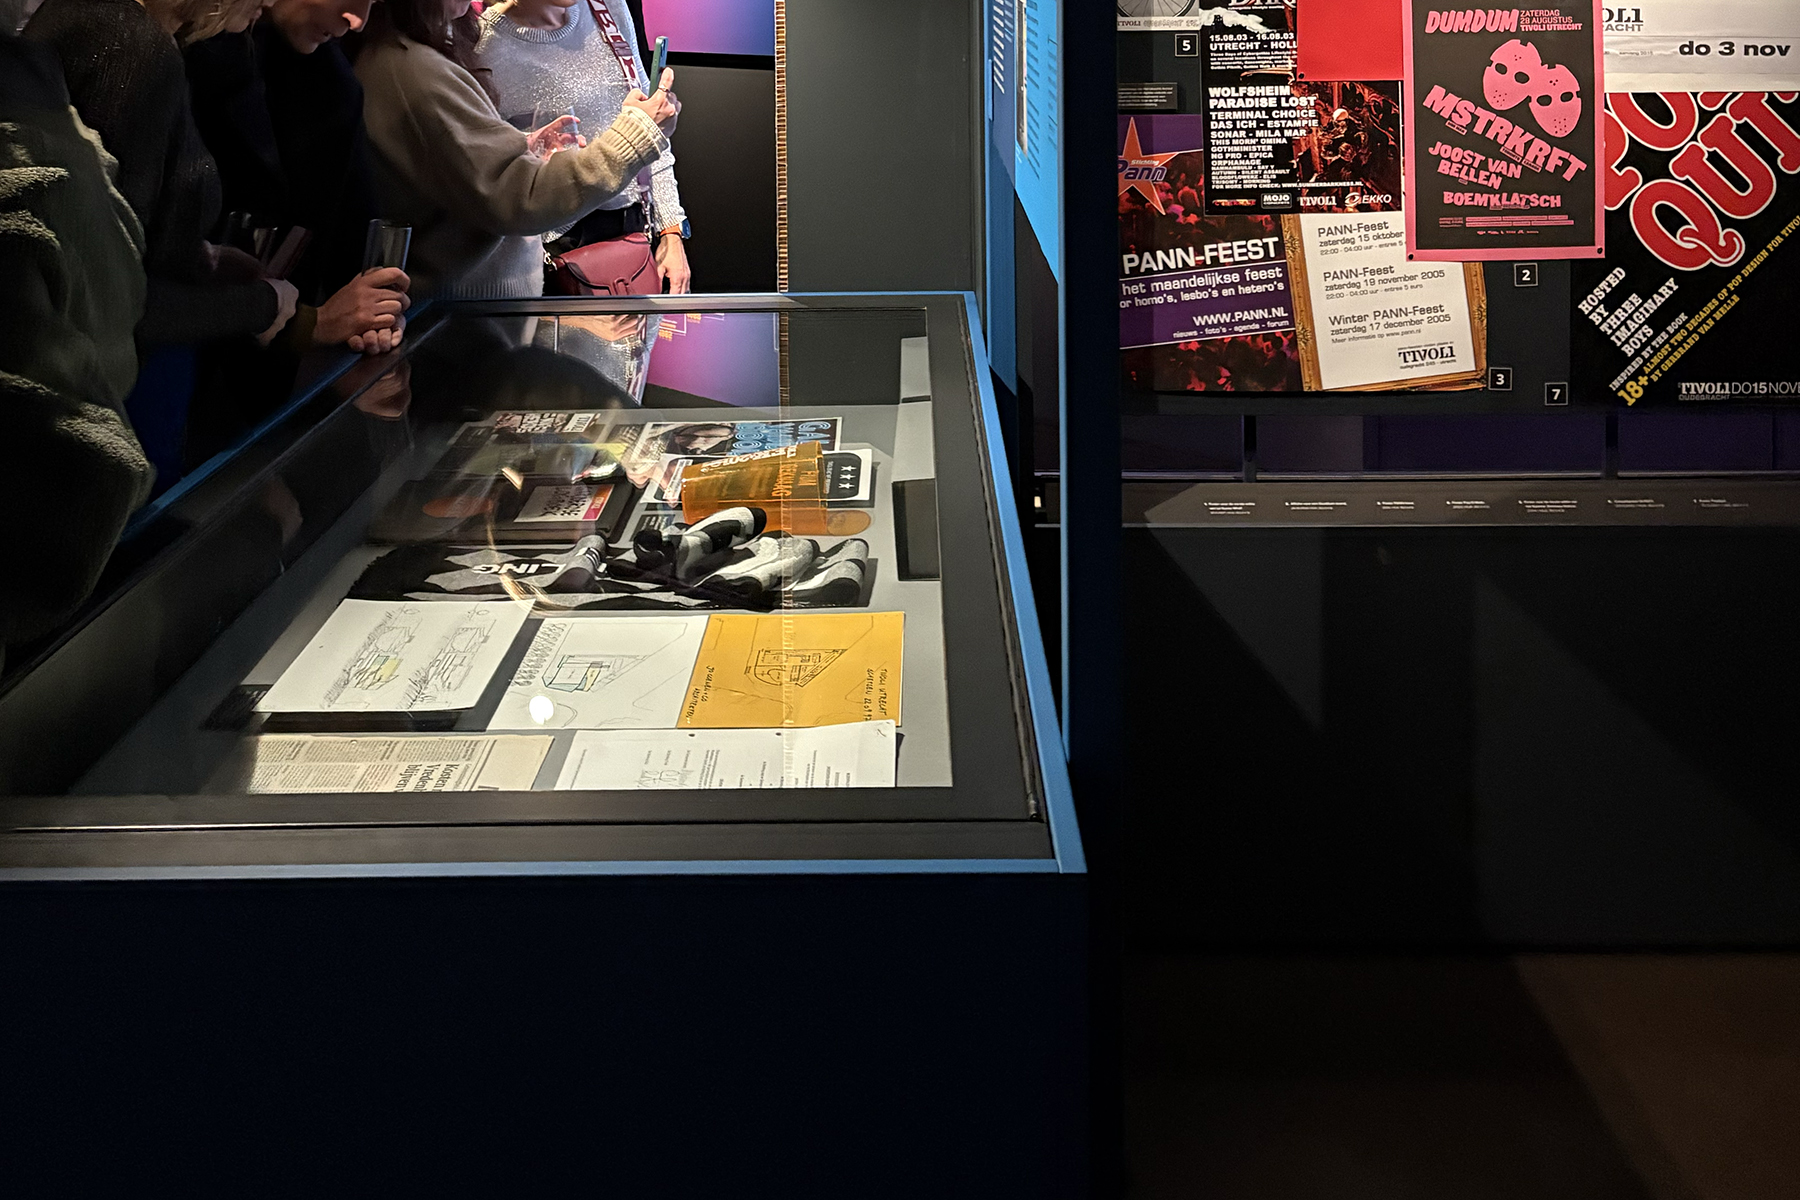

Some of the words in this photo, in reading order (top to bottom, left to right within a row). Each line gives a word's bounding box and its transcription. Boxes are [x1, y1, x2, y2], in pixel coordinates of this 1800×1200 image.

[1425, 9, 1519, 33] DUMDUM
[1520, 9, 1560, 17] ZATERDAG
[1531, 16, 1573, 24] AUGUSTUS
[1520, 23, 1546, 31] TIVOLI
[1546, 23, 1583, 31] UTRECHT
[1182, 40, 1191, 52] 5
[1209, 34, 1248, 42] 15.08.03
[1256, 33, 1294, 41] 16.08.03
[1209, 42, 1261, 51] UTRECHT
[1679, 41, 1711, 56] do
[1718, 41, 1736, 56] 3
[1744, 44, 1791, 56] nov
[1208, 86, 1290, 97] WOLFSHEIM
[1209, 97, 1277, 109] PARADISE
[1281, 97, 1317, 107] LOST
[1210, 111, 1269, 120] TERMINAL
[1272, 110, 1316, 118] CHOICE
[1210, 121, 1233, 129] DAS
[1236, 120, 1257, 129] ICH
[1267, 119, 1319, 128] ESTAMPIE
[1210, 131, 1246, 139] SONAR
[1255, 130, 1281, 138] MILA
[1283, 129, 1307, 137] MAR
[1422, 84, 1587, 182] MSTRKRFT
[1211, 145, 1273, 153] GOTHMINISTER
[1428, 141, 1485, 169] JOOST
[1487, 157, 1523, 179] VAN
[1118, 159, 1167, 182] Pann
[1437, 159, 1502, 190] BELLEN
[1264, 194, 1290, 202] MOJO
[1363, 194, 1392, 204] EKKO
[1443, 191, 1561, 208] BOEMKLATSCH
[1318, 221, 1389, 238] PANN-Feest
[1319, 235, 1356, 248] zaterdag
[1358, 234, 1371, 243] 15
[1372, 231, 1405, 241] oktober
[1122, 237, 1279, 275] PANN-FEEST
[1320, 248, 1339, 256] 22:00
[1122, 283, 1146, 296] het
[1150, 272, 1240, 293] maandelijkse
[1245, 267, 1283, 282] feest
[1323, 265, 1395, 282] PANN-Feest
[1325, 280, 1361, 292] zaterdag
[1363, 278, 1376, 287] 19
[1378, 274, 1419, 286] november
[1421, 270, 1446, 280] 2005
[1522, 269, 1531, 281] 2
[1134, 294, 1178, 307] homo's,
[1180, 289, 1219, 302] lesbo's
[1221, 288, 1236, 297] en
[1238, 282, 1285, 295] hetero's
[1326, 292, 1345, 300] 22:00
[1578, 266, 1626, 315] HOSTED
[1610, 277, 1679, 347] IMAGINARY
[1642, 344, 1674, 375] ALMOST
[1669, 327, 1689, 346] TWO
[1685, 298, 1720, 330] DECADES
[1716, 287, 1730, 301] OF
[1726, 274, 1744, 292] POP
[1741, 248, 1769, 278] DESIGN
[1766, 234, 1784, 252] FOR
[1192, 307, 1289, 327] WWW.PANN.NL
[1329, 311, 1370, 326] Winter
[1373, 304, 1445, 321] PANN-Feest
[1588, 304, 1609, 325] BY
[1599, 293, 1643, 335] THREE
[1173, 330, 1199, 339] nieuws
[1204, 326, 1228, 335] foto's
[1233, 323, 1260, 333] agenda
[1267, 319, 1290, 329] forum
[1330, 325, 1367, 337] zaterdag
[1369, 323, 1381, 331] 17
[1383, 318, 1425, 329] december
[1427, 314, 1452, 324] 2005
[1348, 333, 1377, 342] informatie
[1621, 324, 1654, 357] BOYS
[1609, 356, 1644, 391] INSPIRED
[1641, 346, 1654, 359] BY
[1651, 331, 1669, 349] THE
[1666, 312, 1689, 335] BOOK
[1650, 369, 1664, 382] BY
[1660, 333, 1700, 372] GERBRAND
[1697, 316, 1716, 336] VAN
[1496, 373, 1505, 385] 3
[1552, 389, 1561, 400] 7
[1617, 375, 1649, 407] 18+
[395, 764, 423, 788] blijven
[434, 764, 460, 788] Kosten
